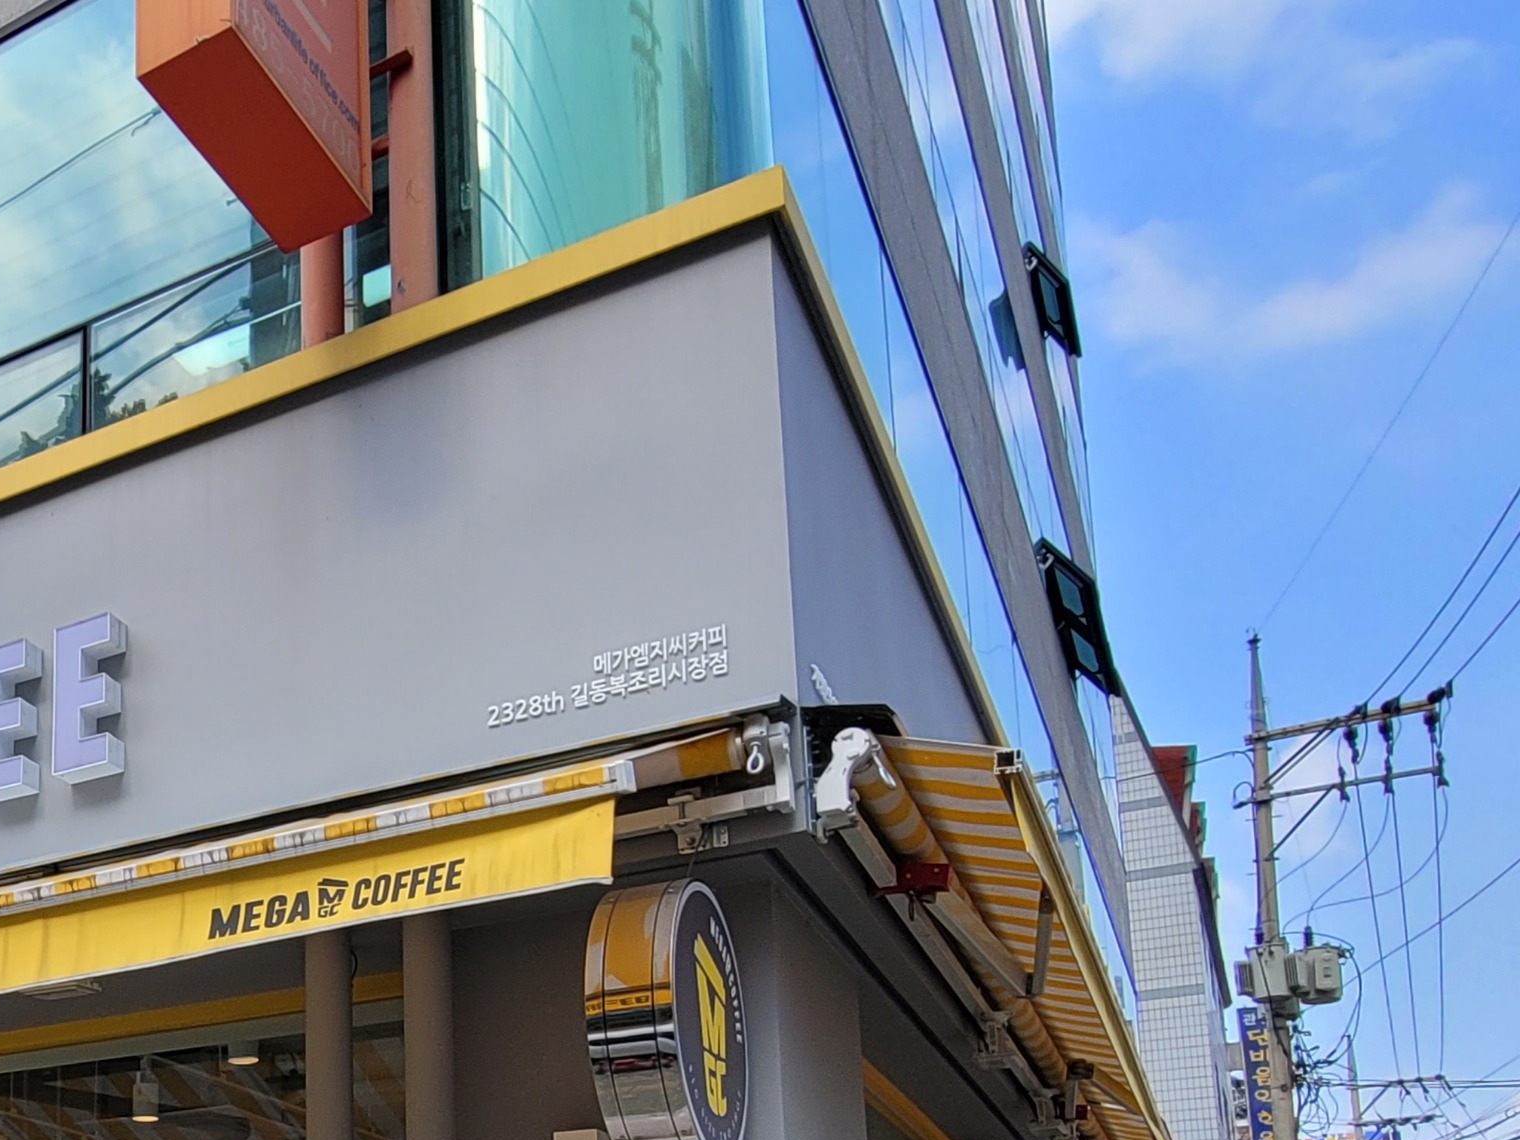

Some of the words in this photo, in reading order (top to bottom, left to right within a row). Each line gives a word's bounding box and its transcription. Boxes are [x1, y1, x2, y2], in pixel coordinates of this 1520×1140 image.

[487, 691, 565, 727] 2328th
[570, 649, 729, 708] 길동복조리시장점
[593, 623, 728, 675] 메가엠지씨커피
[208, 890, 311, 940] MEGA
[351, 857, 466, 910] COFFEE
